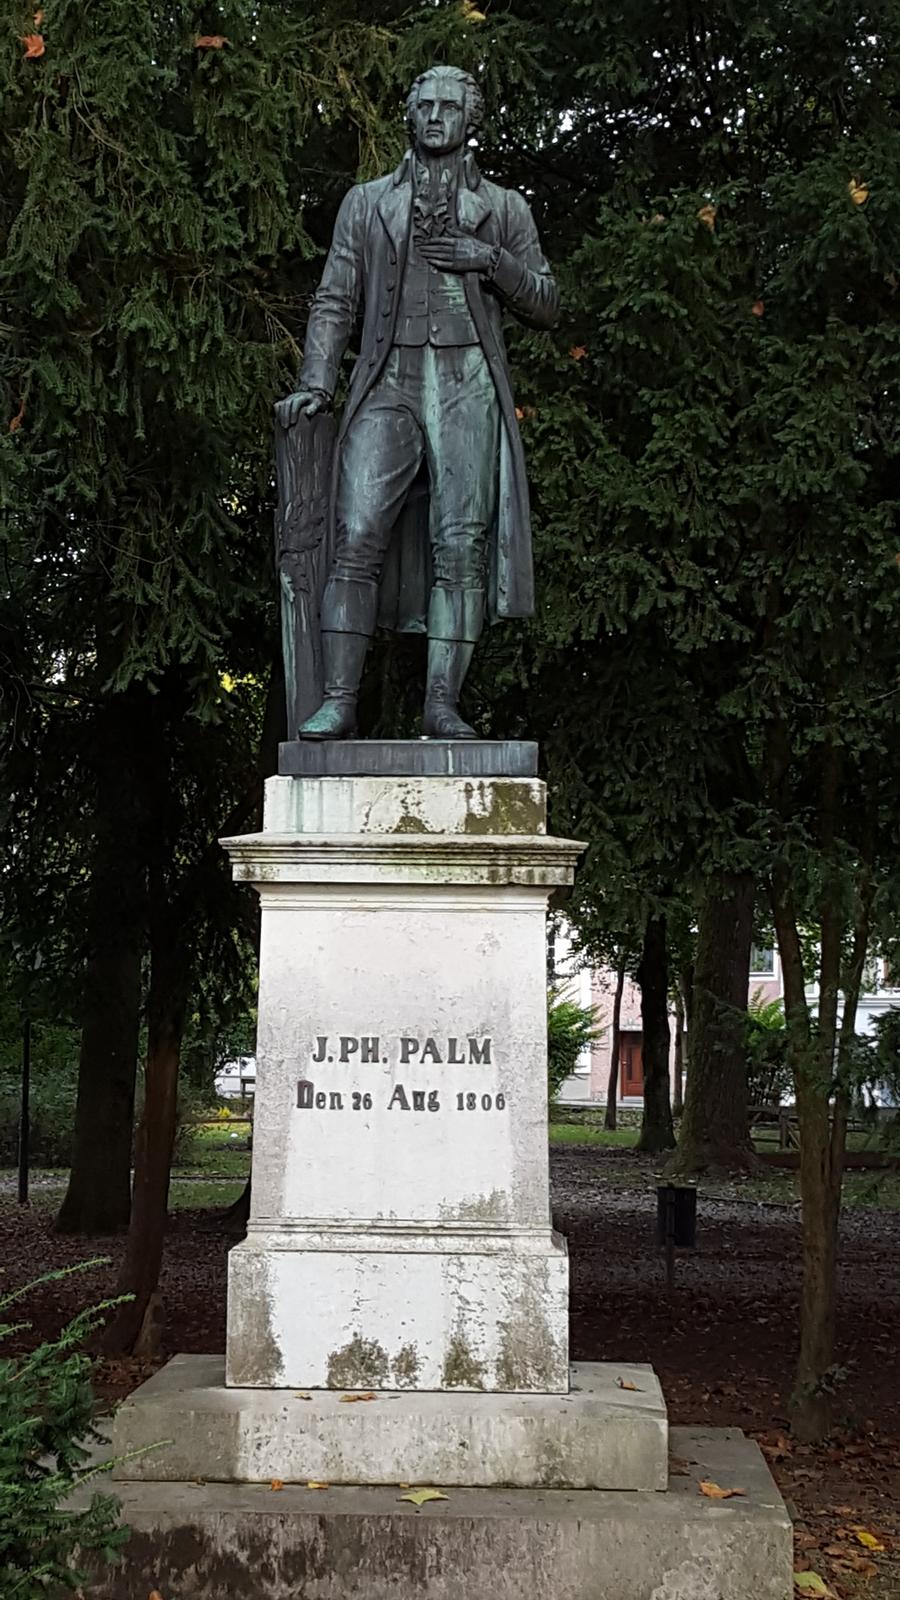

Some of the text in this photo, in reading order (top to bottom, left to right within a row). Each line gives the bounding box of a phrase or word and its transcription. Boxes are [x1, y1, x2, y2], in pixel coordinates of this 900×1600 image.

[399, 1037, 492, 1065] PALM
[296, 1079, 506, 1112] Den 26 Aug 1806
